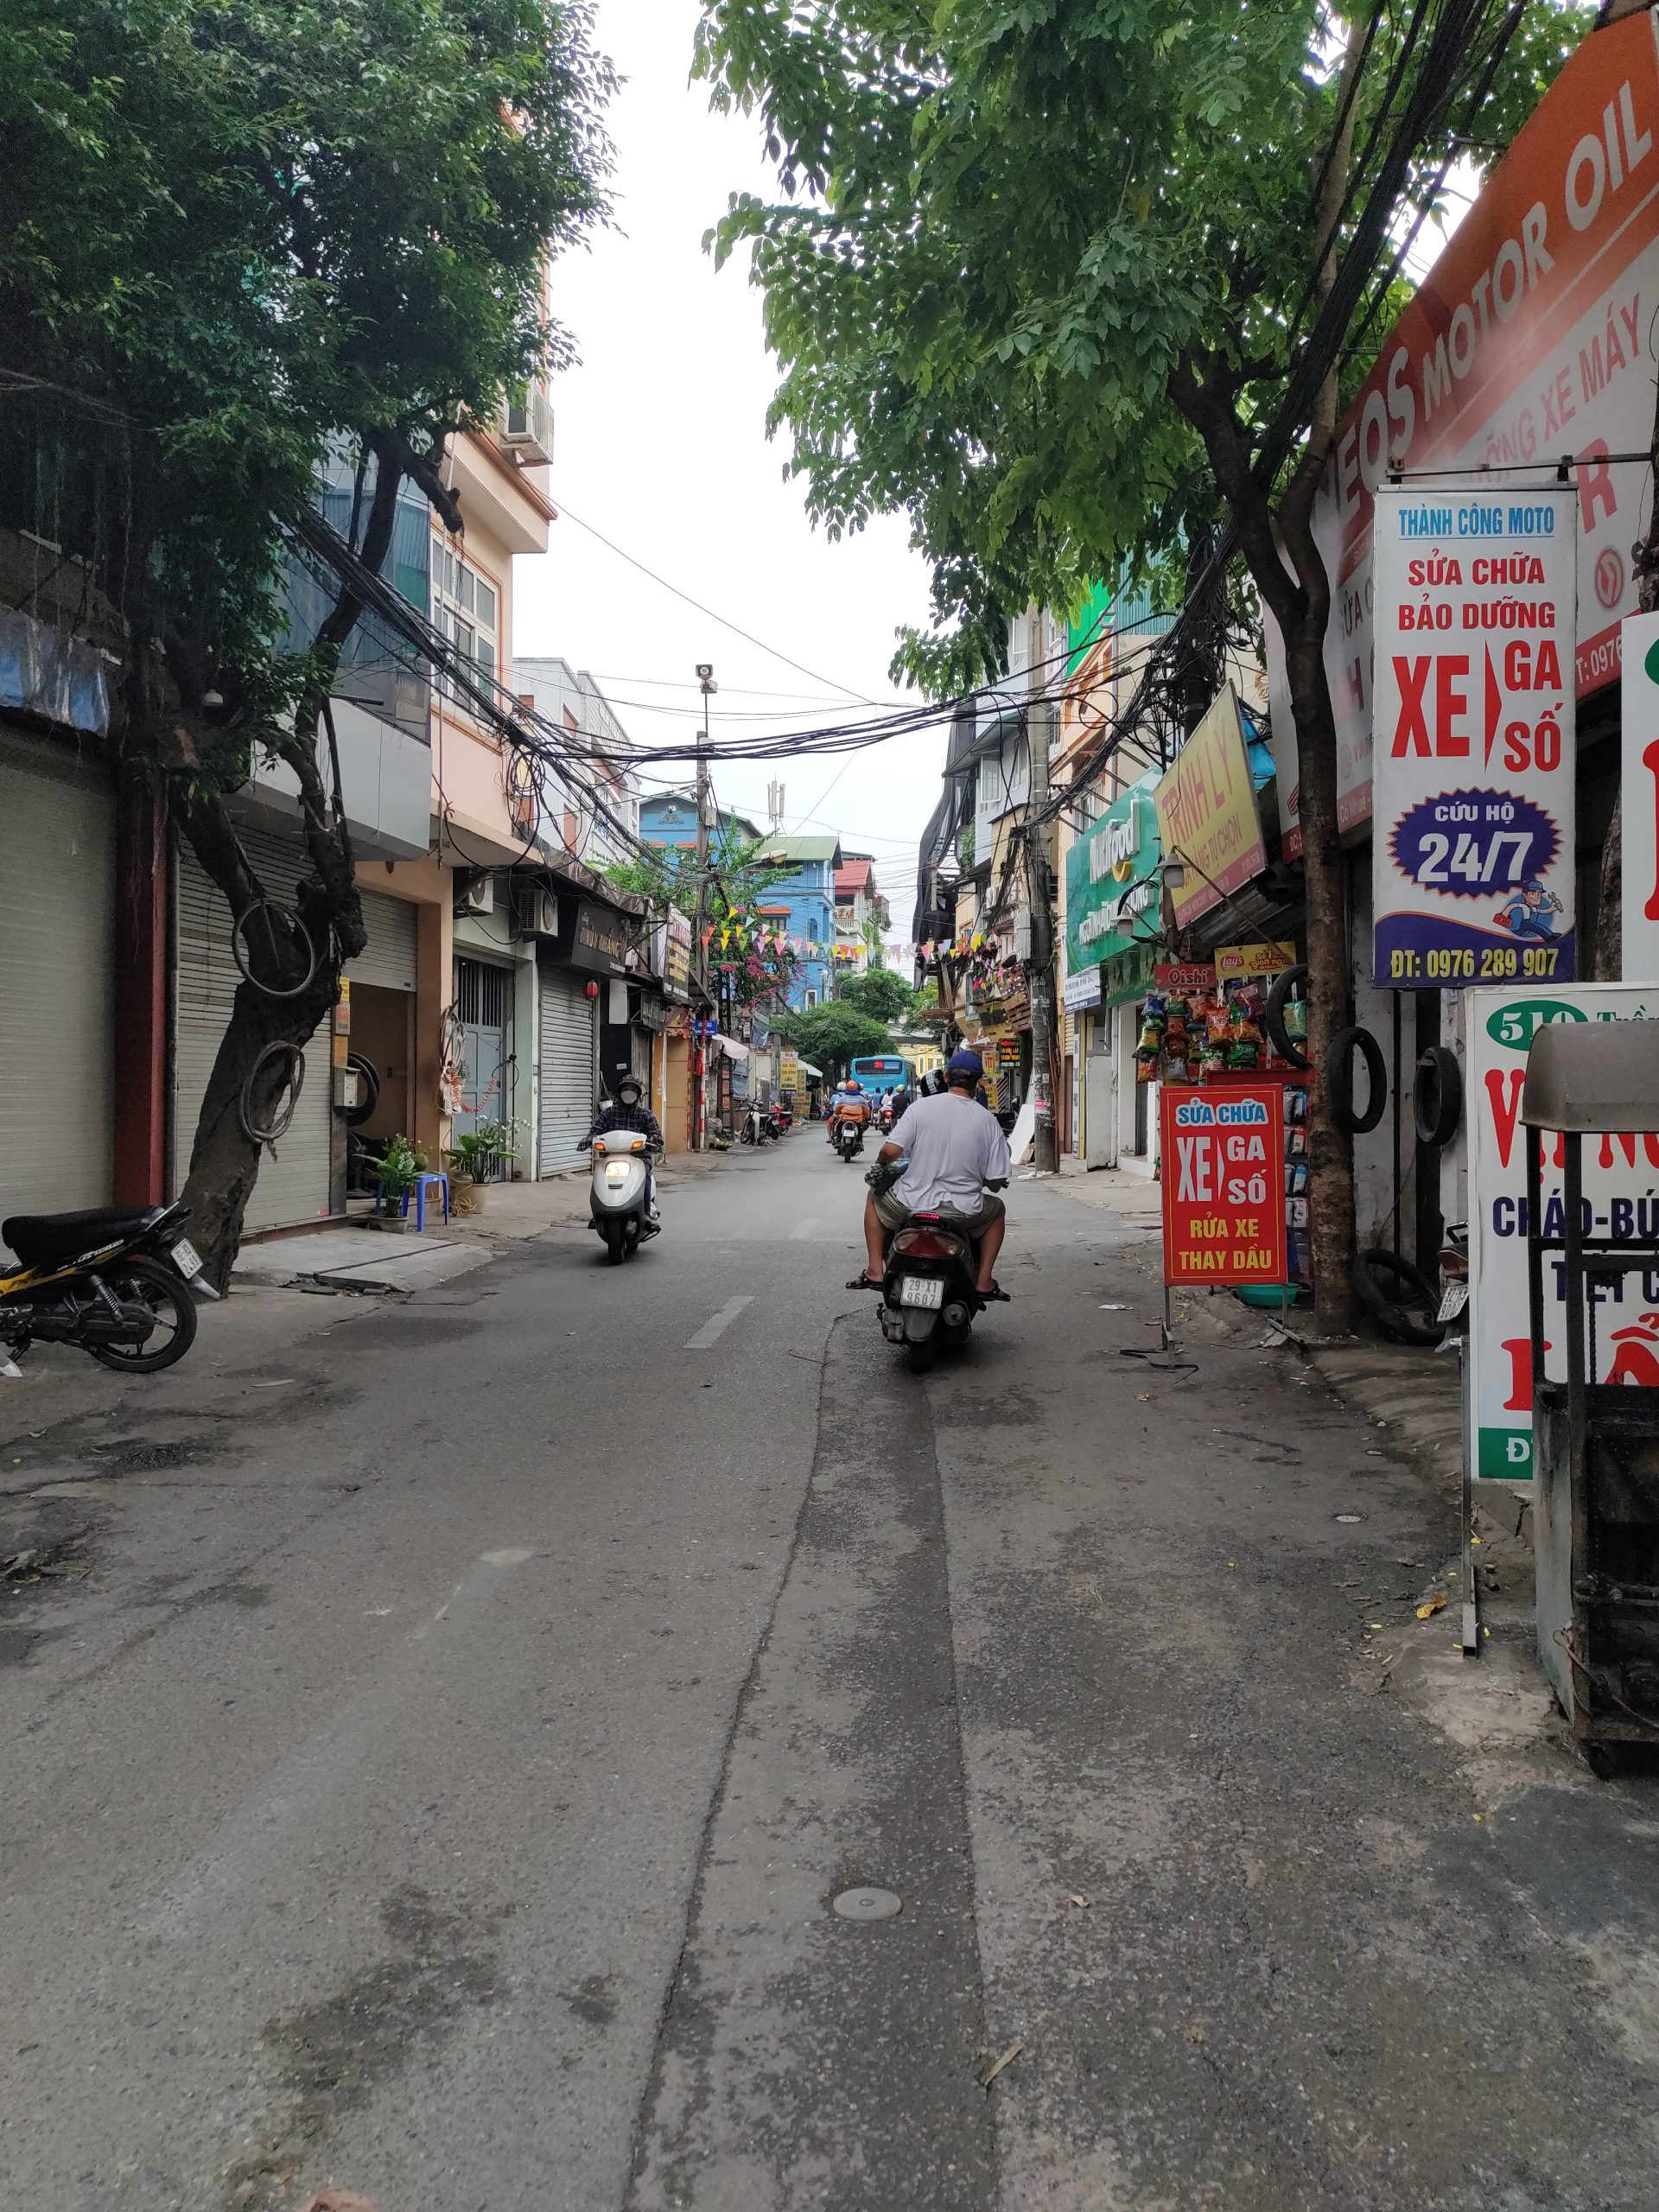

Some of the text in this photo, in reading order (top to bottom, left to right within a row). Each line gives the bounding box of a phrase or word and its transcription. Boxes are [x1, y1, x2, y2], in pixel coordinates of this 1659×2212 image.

[1422, 200, 1558, 423] MOTOR
[1565, 79, 1654, 232] OIL
[1540, 365, 1579, 442] XE
[1579, 291, 1642, 404] MÁY
[1398, 502, 1554, 537] THÀNH CÔNG MOTO
[1408, 547, 1463, 588] SỬA
[1471, 550, 1546, 587] CHỮA
[1398, 594, 1453, 632] BẢO
[1462, 594, 1556, 630] DƯỠNG
[1503, 639, 1562, 691] GA
[1390, 654, 1471, 759] XE
[1503, 701, 1563, 773] SỐ
[1434, 800, 1516, 826] CỨU HỘ
[1417, 830, 1535, 884] 24/7
[1167, 968, 1210, 986] Oishi
[1390, 947, 1560, 981] ĐT: 0976 289 907
[1178, 1096, 1266, 1124] SỬA CHỮA
[1227, 1135, 1266, 1162] GA
[1176, 1135, 1213, 1203] XE
[1227, 1168, 1267, 1205] SỐ
[1190, 1212, 1260, 1240] RỬA XE
[1179, 1243, 1273, 1271] THAY DẦU
[908, 1279, 938, 1294] 29-X1
